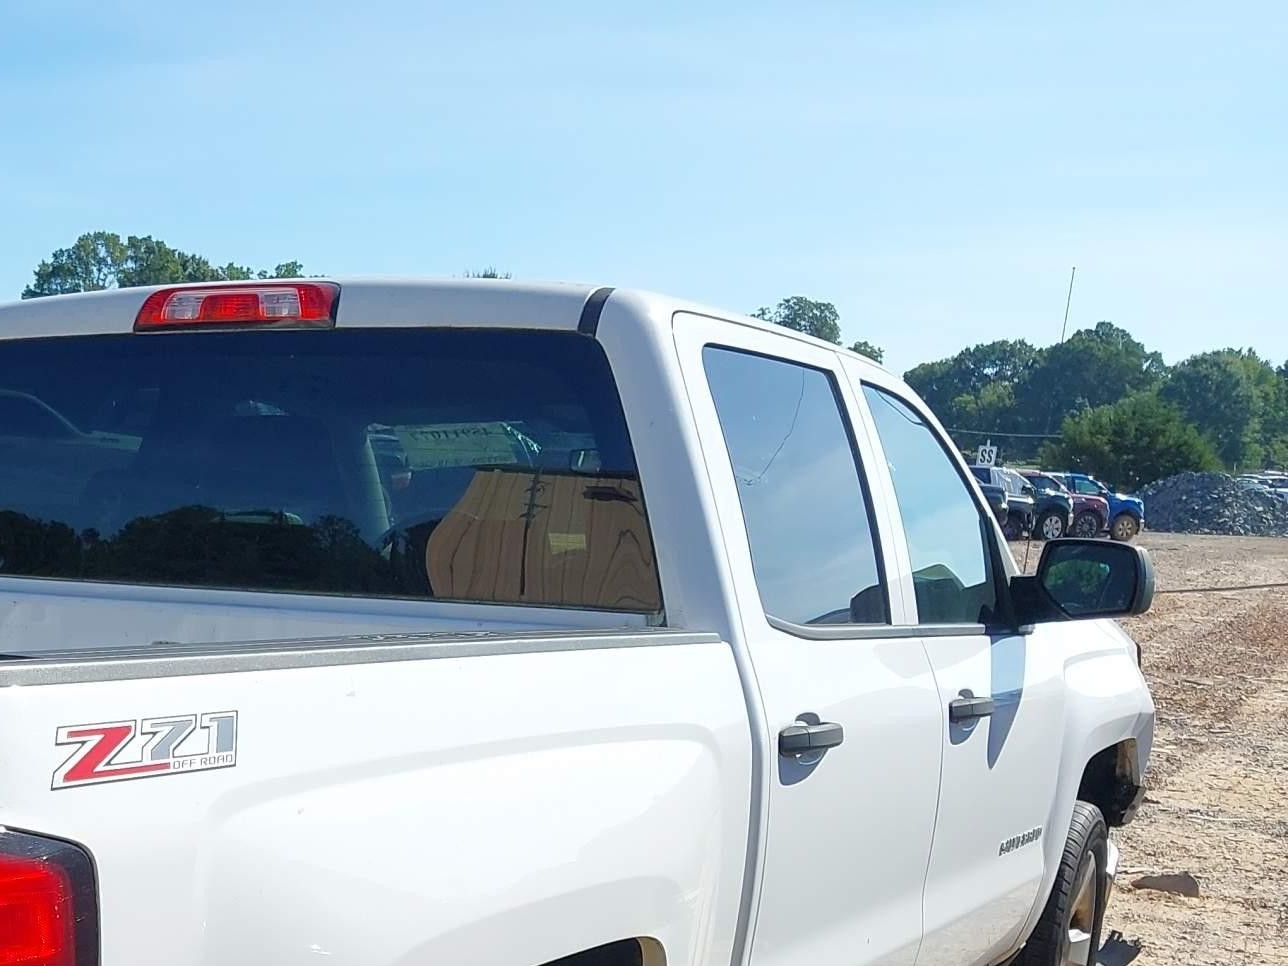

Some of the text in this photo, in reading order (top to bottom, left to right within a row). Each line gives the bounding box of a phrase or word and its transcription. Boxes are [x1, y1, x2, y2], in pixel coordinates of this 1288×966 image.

[979, 448, 994, 464] SS
[53, 711, 238, 789] Z71
[173, 754, 233, 770] OFF ROAD
